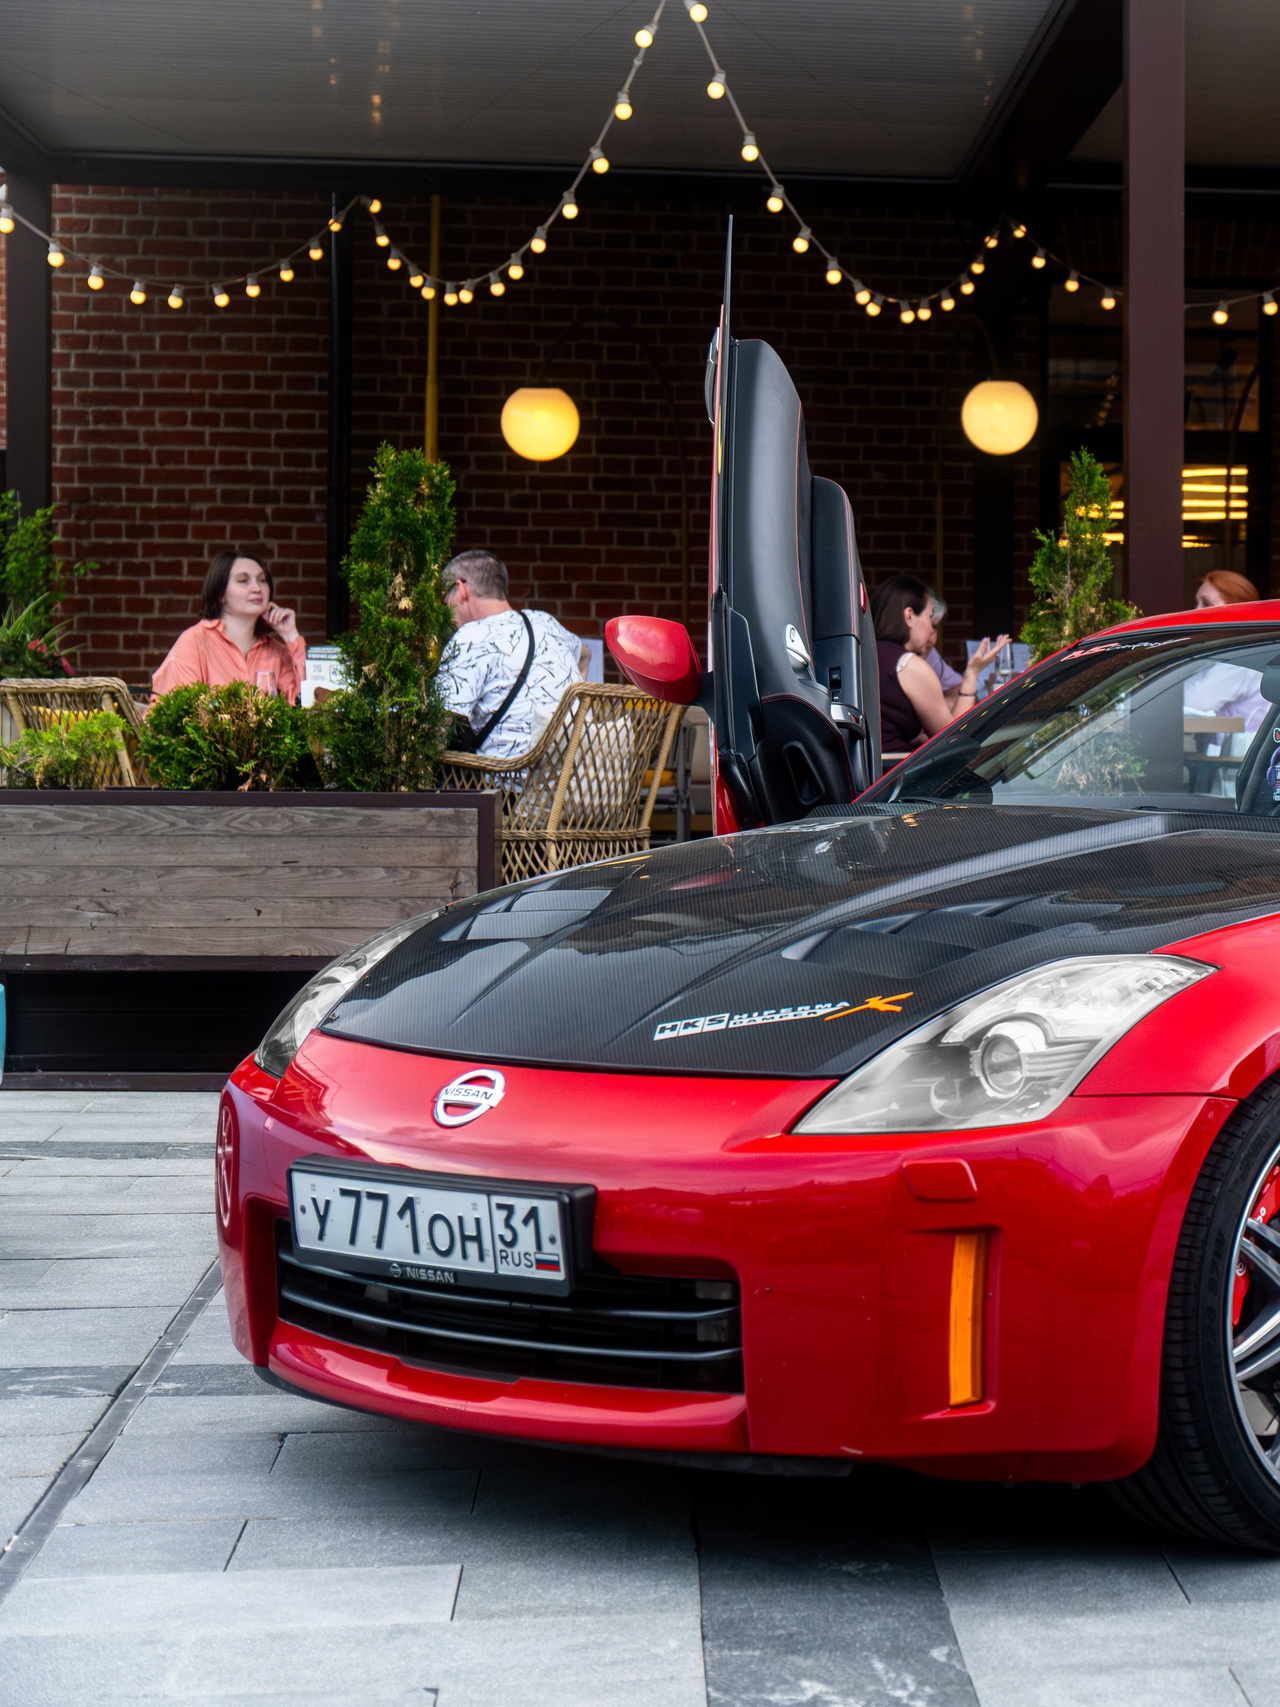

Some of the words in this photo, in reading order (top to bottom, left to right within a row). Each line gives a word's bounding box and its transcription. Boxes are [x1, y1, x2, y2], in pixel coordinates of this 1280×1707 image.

[655, 1014, 729, 1039] HKS
[731, 1010, 819, 1027] DAMPER
[444, 1087, 494, 1100] NISSAN
[494, 1202, 543, 1251] 31
[499, 1250, 535, 1268] RUS
[405, 1266, 455, 1284] NISSAN
